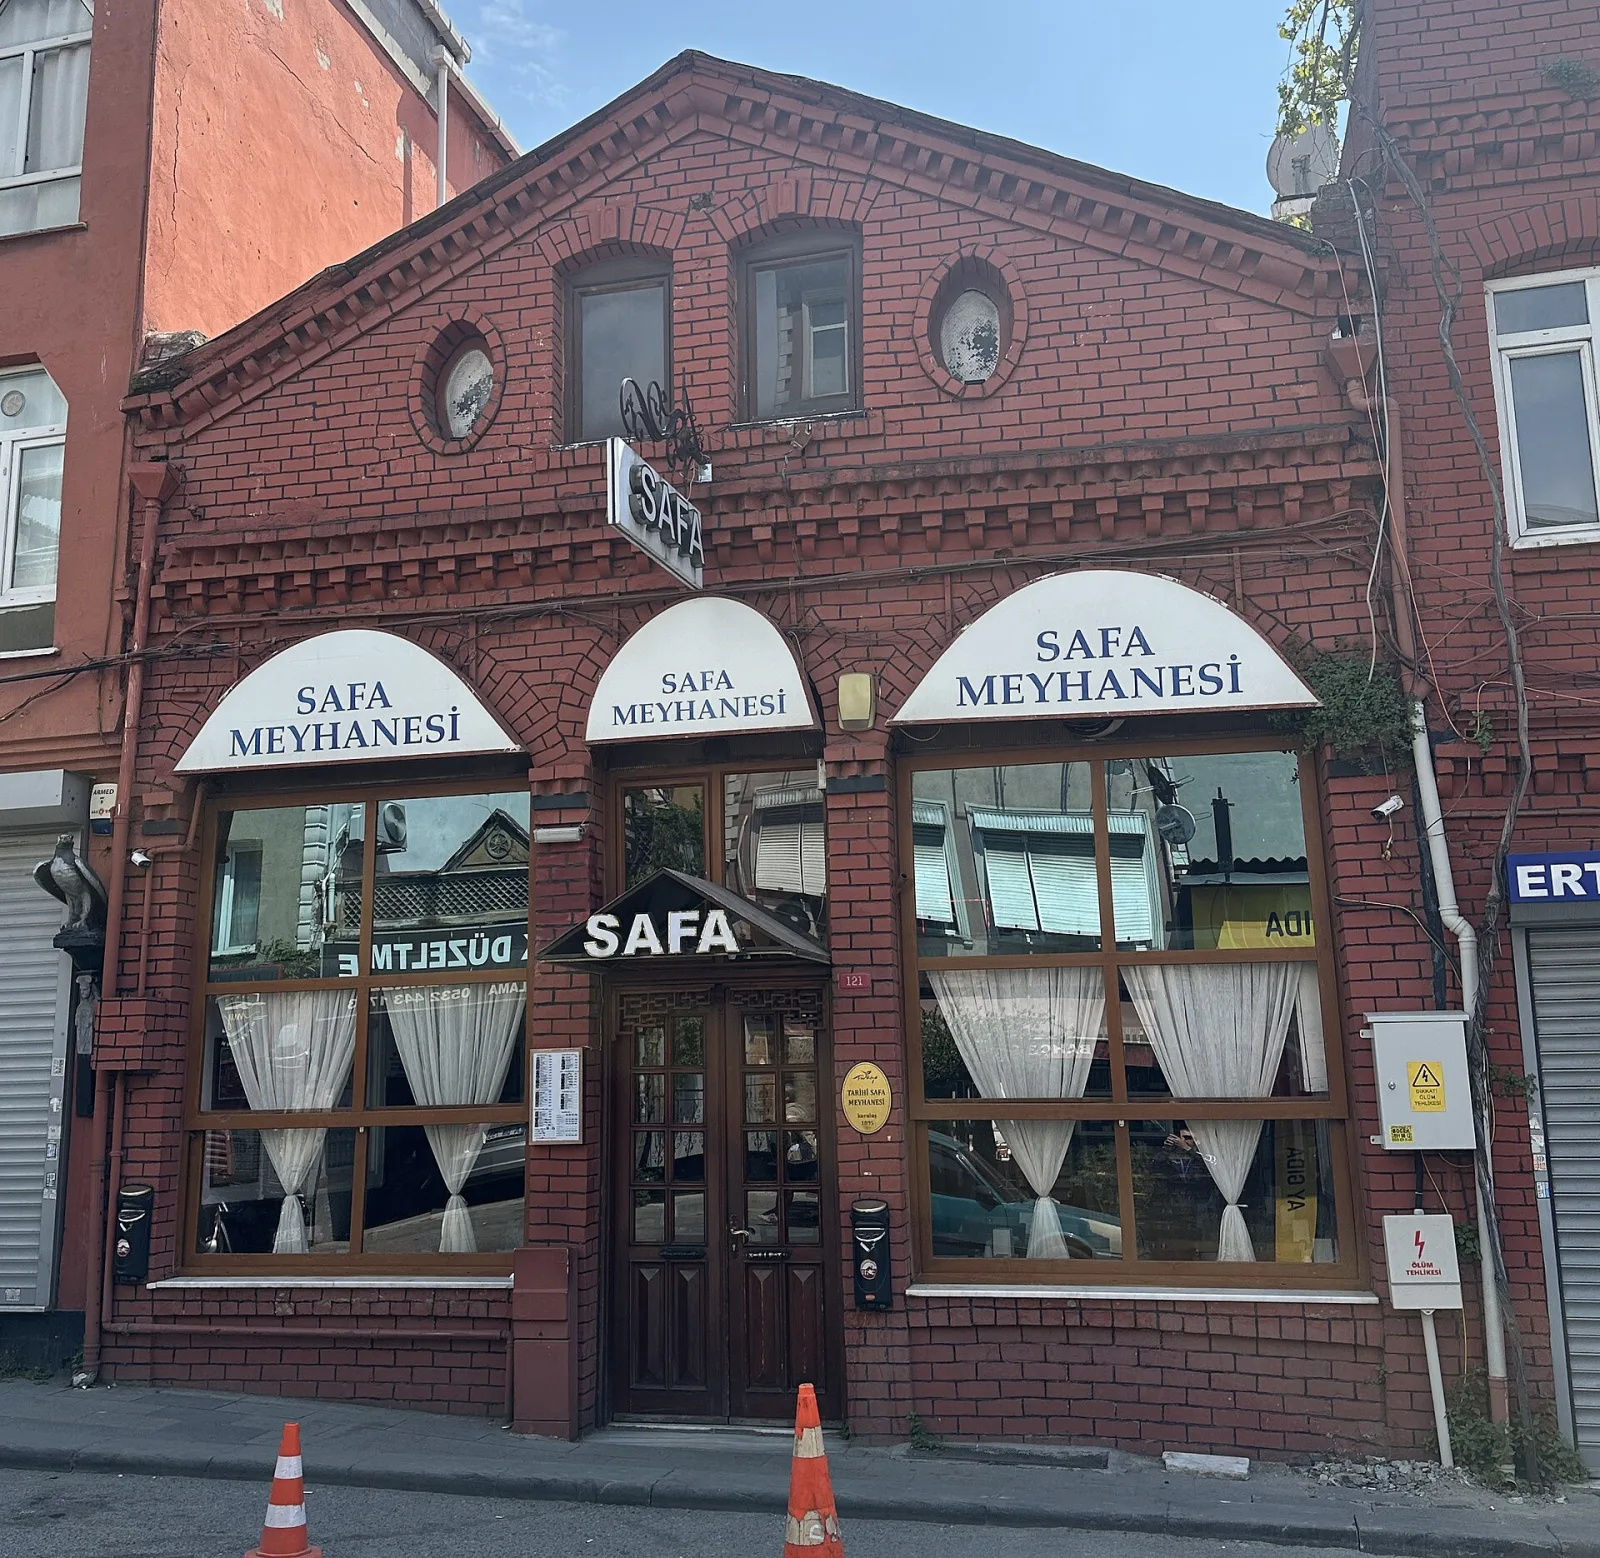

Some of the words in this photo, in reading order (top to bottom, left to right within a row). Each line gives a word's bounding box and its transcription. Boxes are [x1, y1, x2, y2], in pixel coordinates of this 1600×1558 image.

[630, 464, 705, 567] SAFA
[1037, 625, 1156, 662] SAFA
[296, 680, 393, 715] SAFA
[661, 669, 735, 695] SAFA
[955, 653, 1244, 707] MEYHANESİ
[611, 688, 787, 726] MEYHANESİ
[228, 705, 461, 757] MEYHANESİ
[583, 909, 741, 959] SAFA
[846, 975, 863, 986] 121
[848, 1098, 885, 1106] MEYHANESİ
[870, 1088, 886, 1096] SAFA
[1405, 1268, 1442, 1276] TEHLİKESİ
[1411, 1261, 1434, 1269] ÖLÜM
